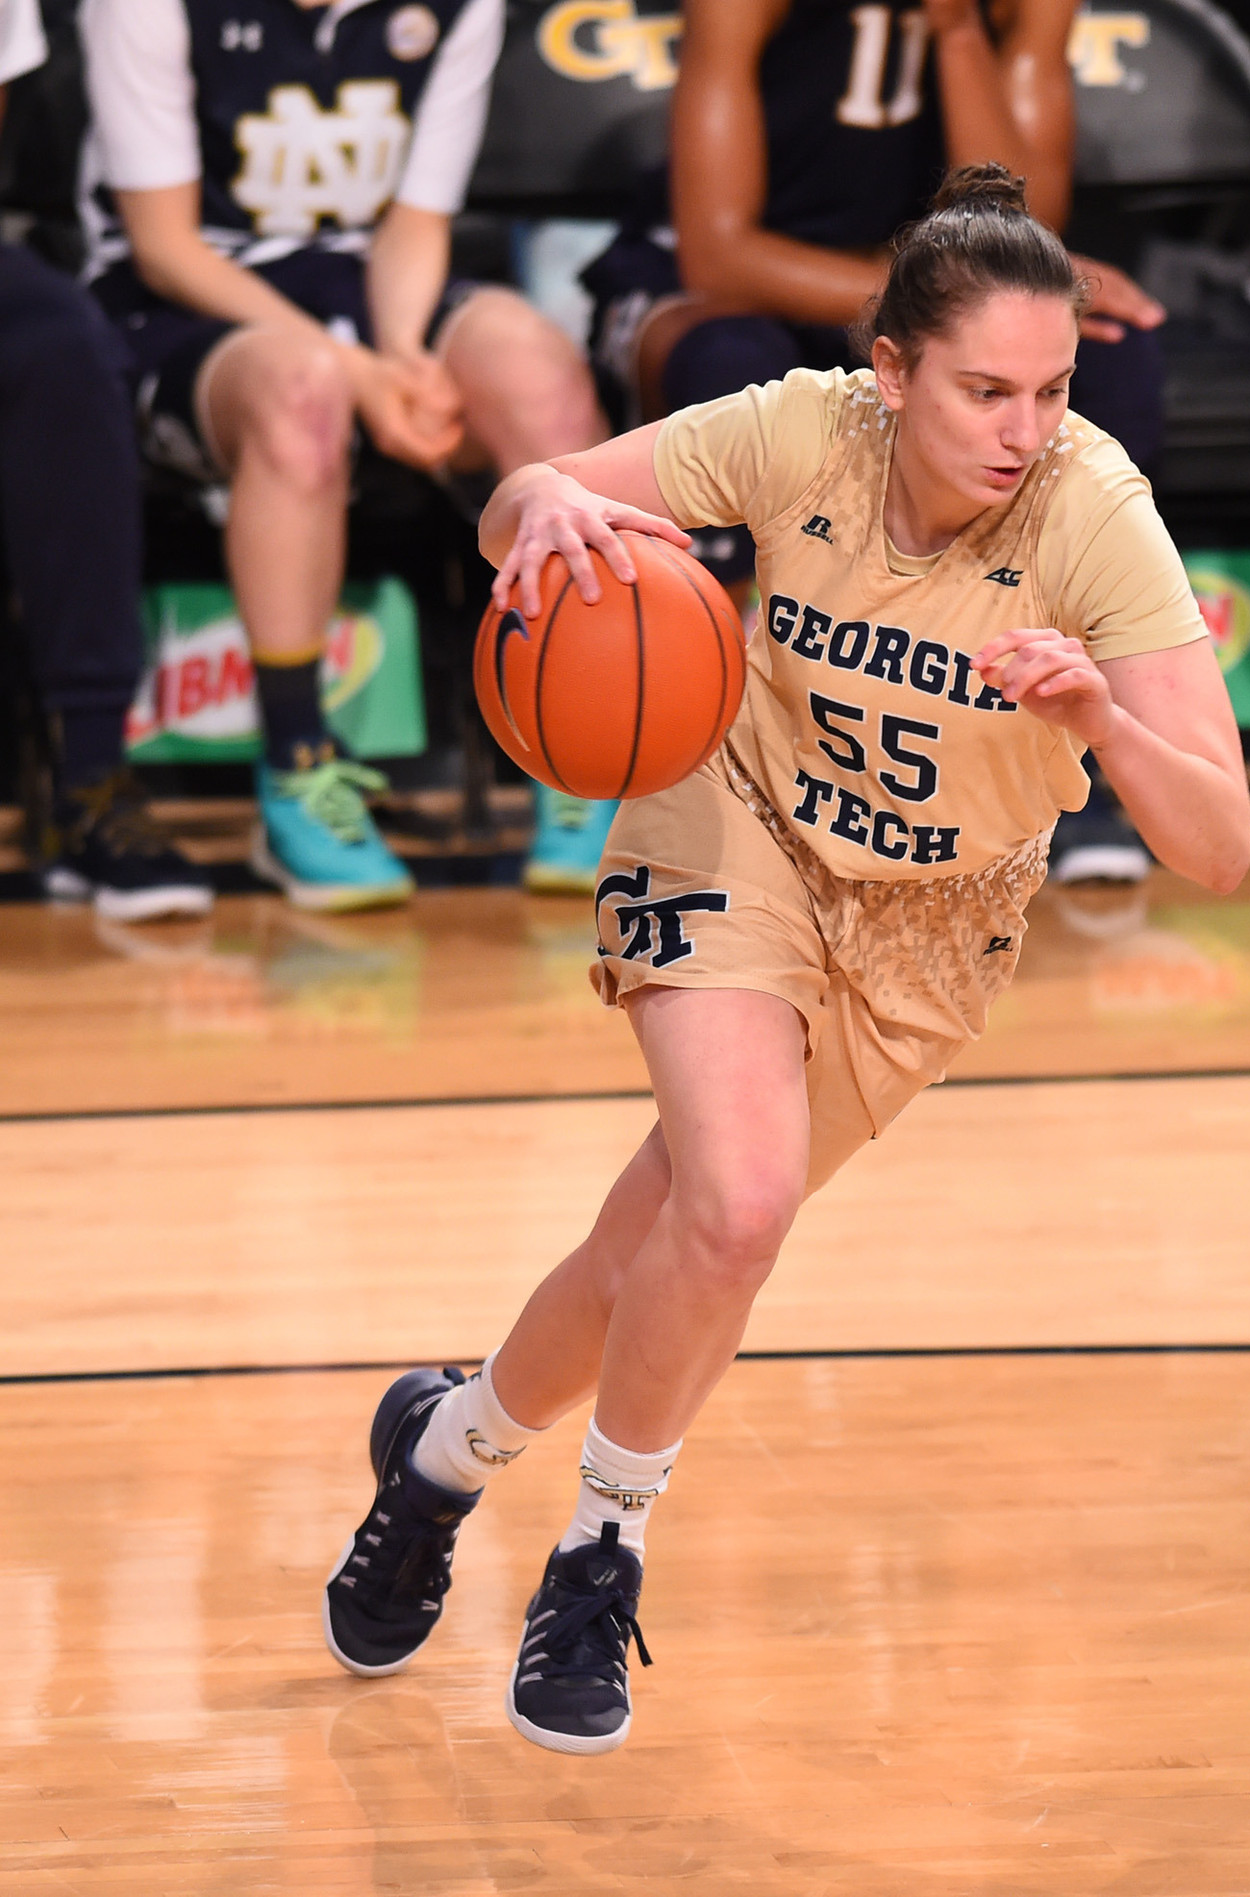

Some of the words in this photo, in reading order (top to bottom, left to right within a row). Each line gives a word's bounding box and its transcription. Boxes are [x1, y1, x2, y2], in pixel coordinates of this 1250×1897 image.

[836, 4, 927, 128] 11
[1066, 9, 1150, 87] T
[808, 688, 943, 805] 55
[791, 766, 961, 866] TECH
